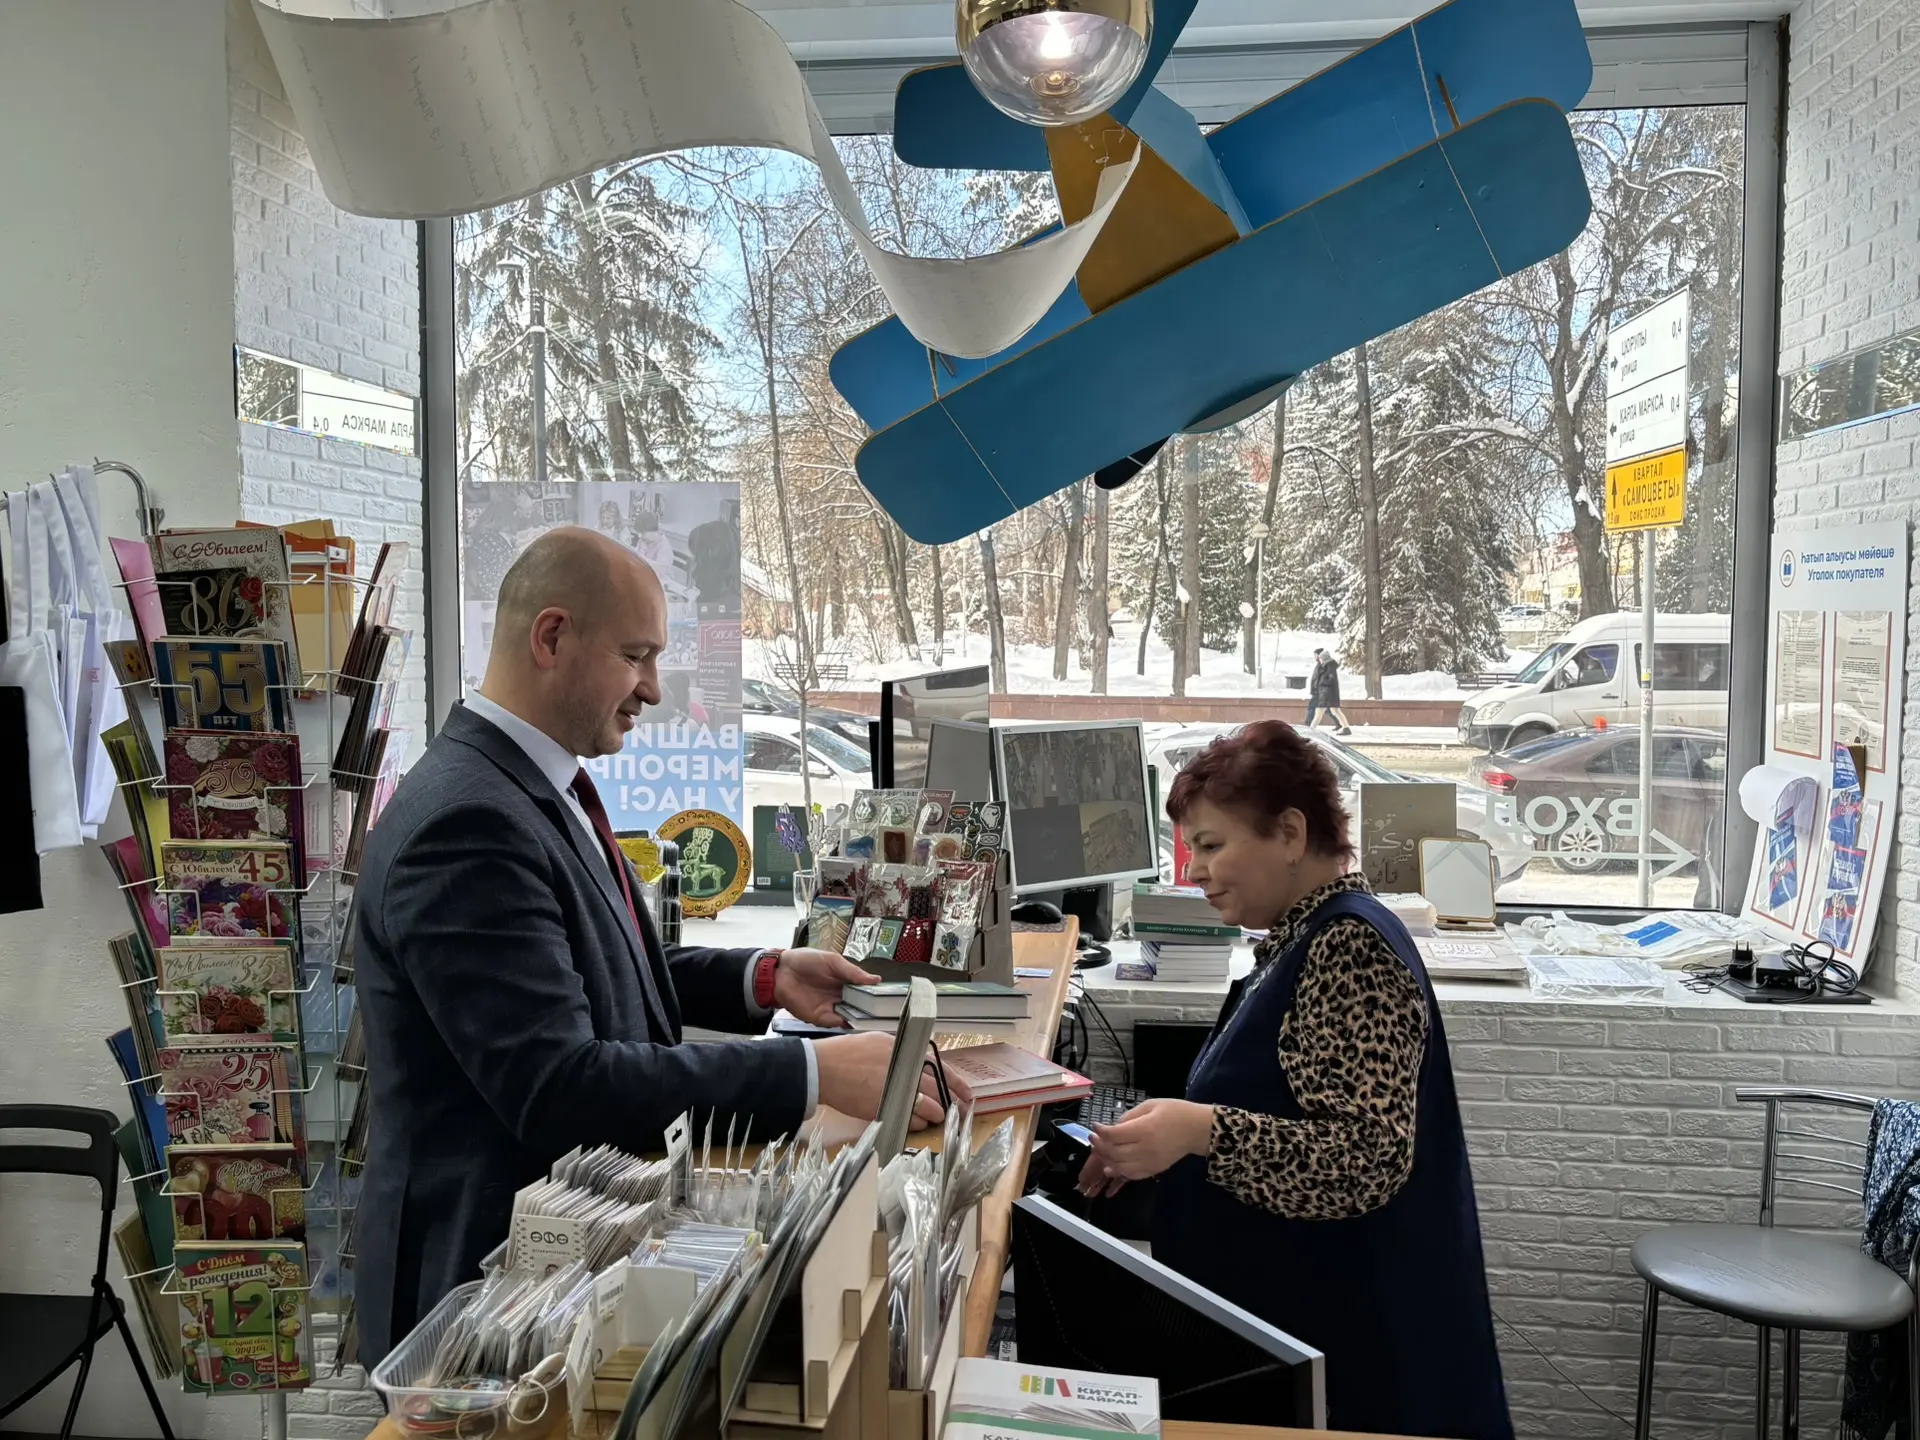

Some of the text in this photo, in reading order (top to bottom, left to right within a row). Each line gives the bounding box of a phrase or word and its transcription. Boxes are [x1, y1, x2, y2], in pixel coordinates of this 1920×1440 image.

[1621, 317, 1682, 358] ЦЮРУПЫ 0,4
[1620, 359, 1638, 381] улица
[1619, 405, 1637, 424] КАРЛА
[1638, 393, 1665, 416] МАРКСА
[1619, 429, 1636, 449] улица
[1633, 462, 1664, 482] КВАРТАЛ
[1622, 477, 1681, 507] «САМОЦВЕТЫ»
[1629, 505, 1666, 522] ОФИС ПРОДАЖ
[173, 540, 268, 559] С Юбилеем!
[1825, 549, 1857, 567] алыусы
[1858, 545, 1895, 560] мөйөшө
[1808, 566, 1885, 583] Уголок покупателя
[170, 651, 268, 716] 55
[170, 851, 285, 883] С Юбилеем! 45
[213, 1051, 275, 1093] 25
[189, 1264, 268, 1289] рождения!
[197, 1259, 207, 1272] С
[202, 1280, 277, 1338] 12
[1076, 1393, 1139, 1406] БАЙРАМ
[1077, 1387, 1143, 1401] КИТАП-
